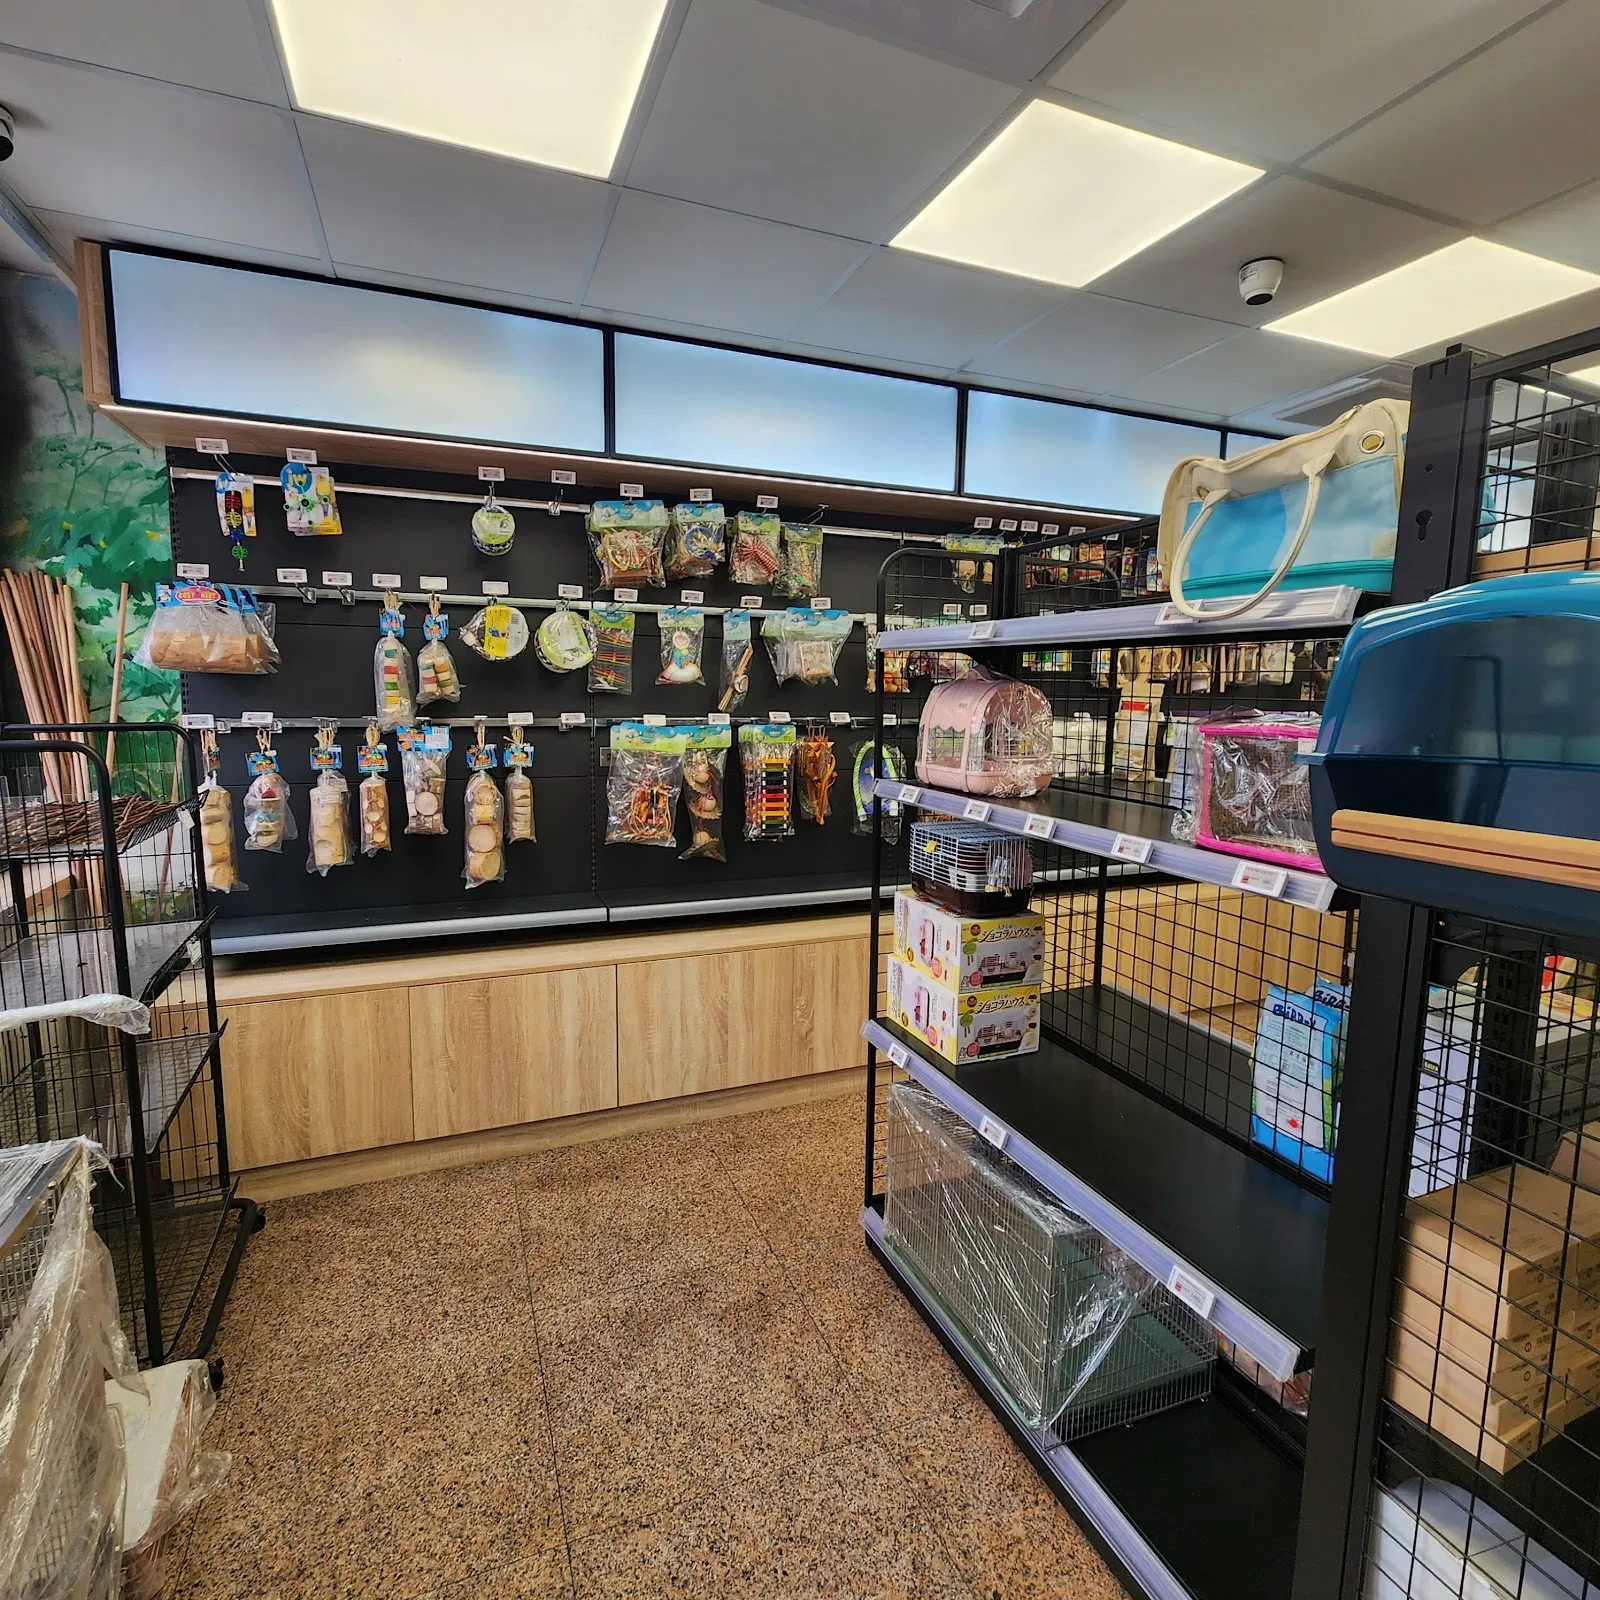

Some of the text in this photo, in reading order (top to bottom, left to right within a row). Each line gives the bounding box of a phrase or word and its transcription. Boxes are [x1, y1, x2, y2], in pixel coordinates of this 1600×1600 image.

[978, 927, 1031, 943] ショコラハウス
[974, 996, 1025, 1014] ショコラハウス
